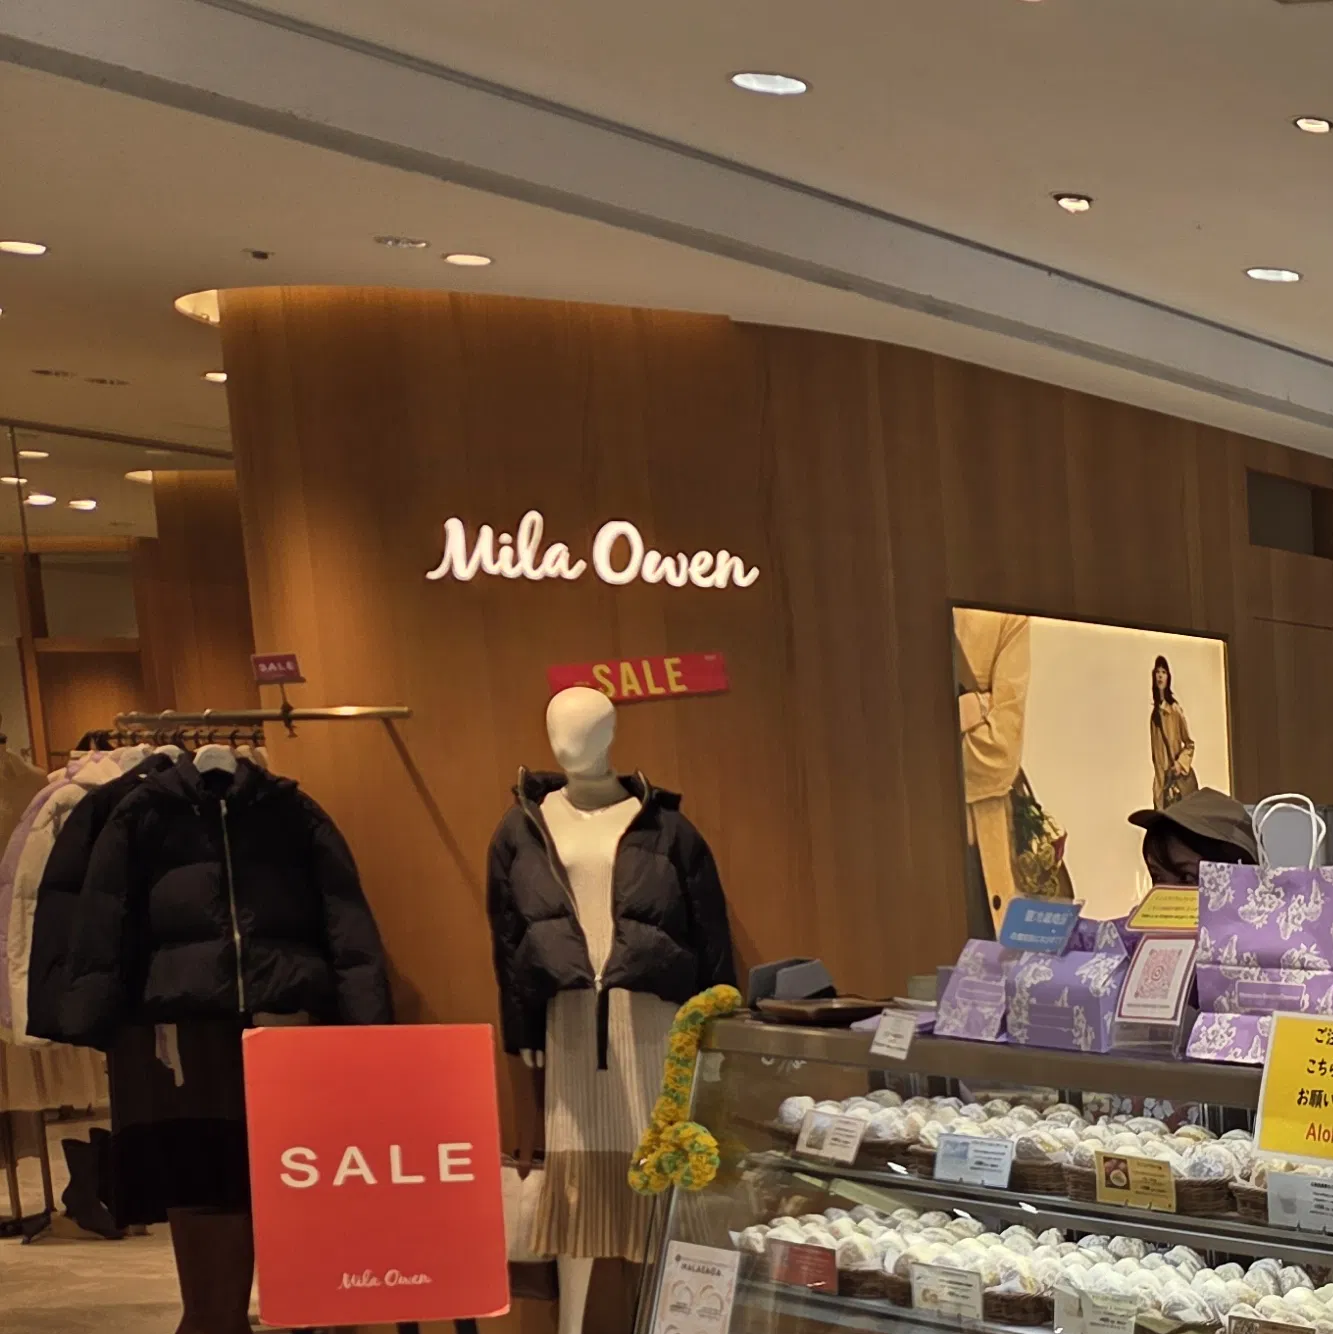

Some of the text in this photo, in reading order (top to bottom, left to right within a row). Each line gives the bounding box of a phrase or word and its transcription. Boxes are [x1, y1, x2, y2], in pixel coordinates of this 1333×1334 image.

[426, 510, 760, 589] Mila Owen
[258, 661, 295, 673] SALE
[593, 656, 690, 699] SALE
[280, 1142, 476, 1188] SALE
[337, 1269, 432, 1290] Mila Owen
